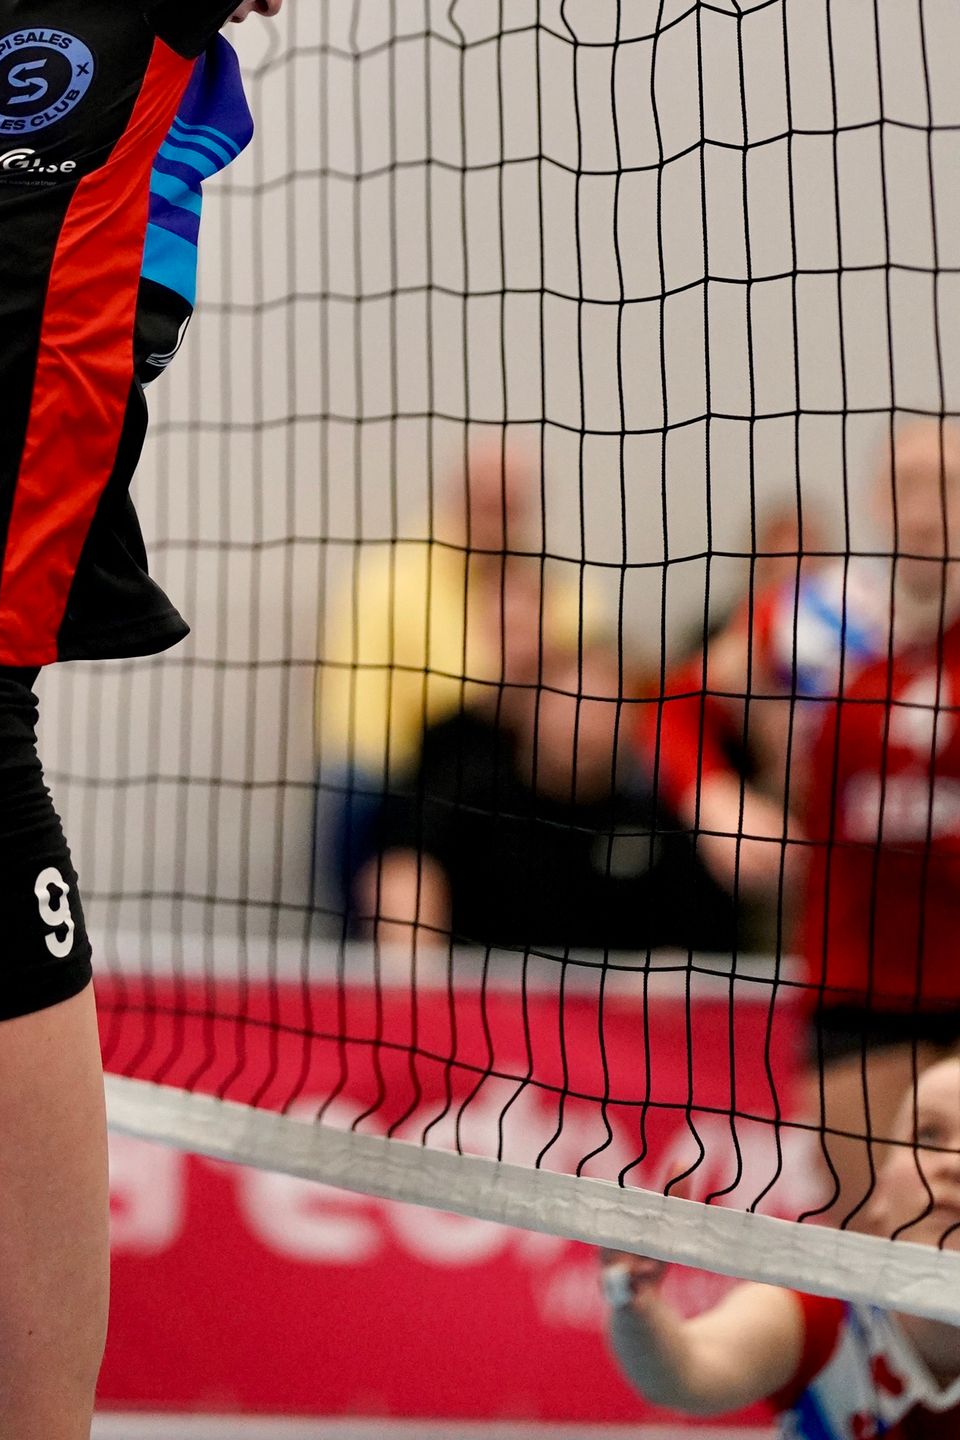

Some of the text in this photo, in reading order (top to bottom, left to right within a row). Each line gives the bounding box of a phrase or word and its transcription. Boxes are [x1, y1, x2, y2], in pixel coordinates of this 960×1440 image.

[13, 31, 73, 50] SALES
[30, 89, 81, 127] CLUB
[34, 867, 75, 958] 9
